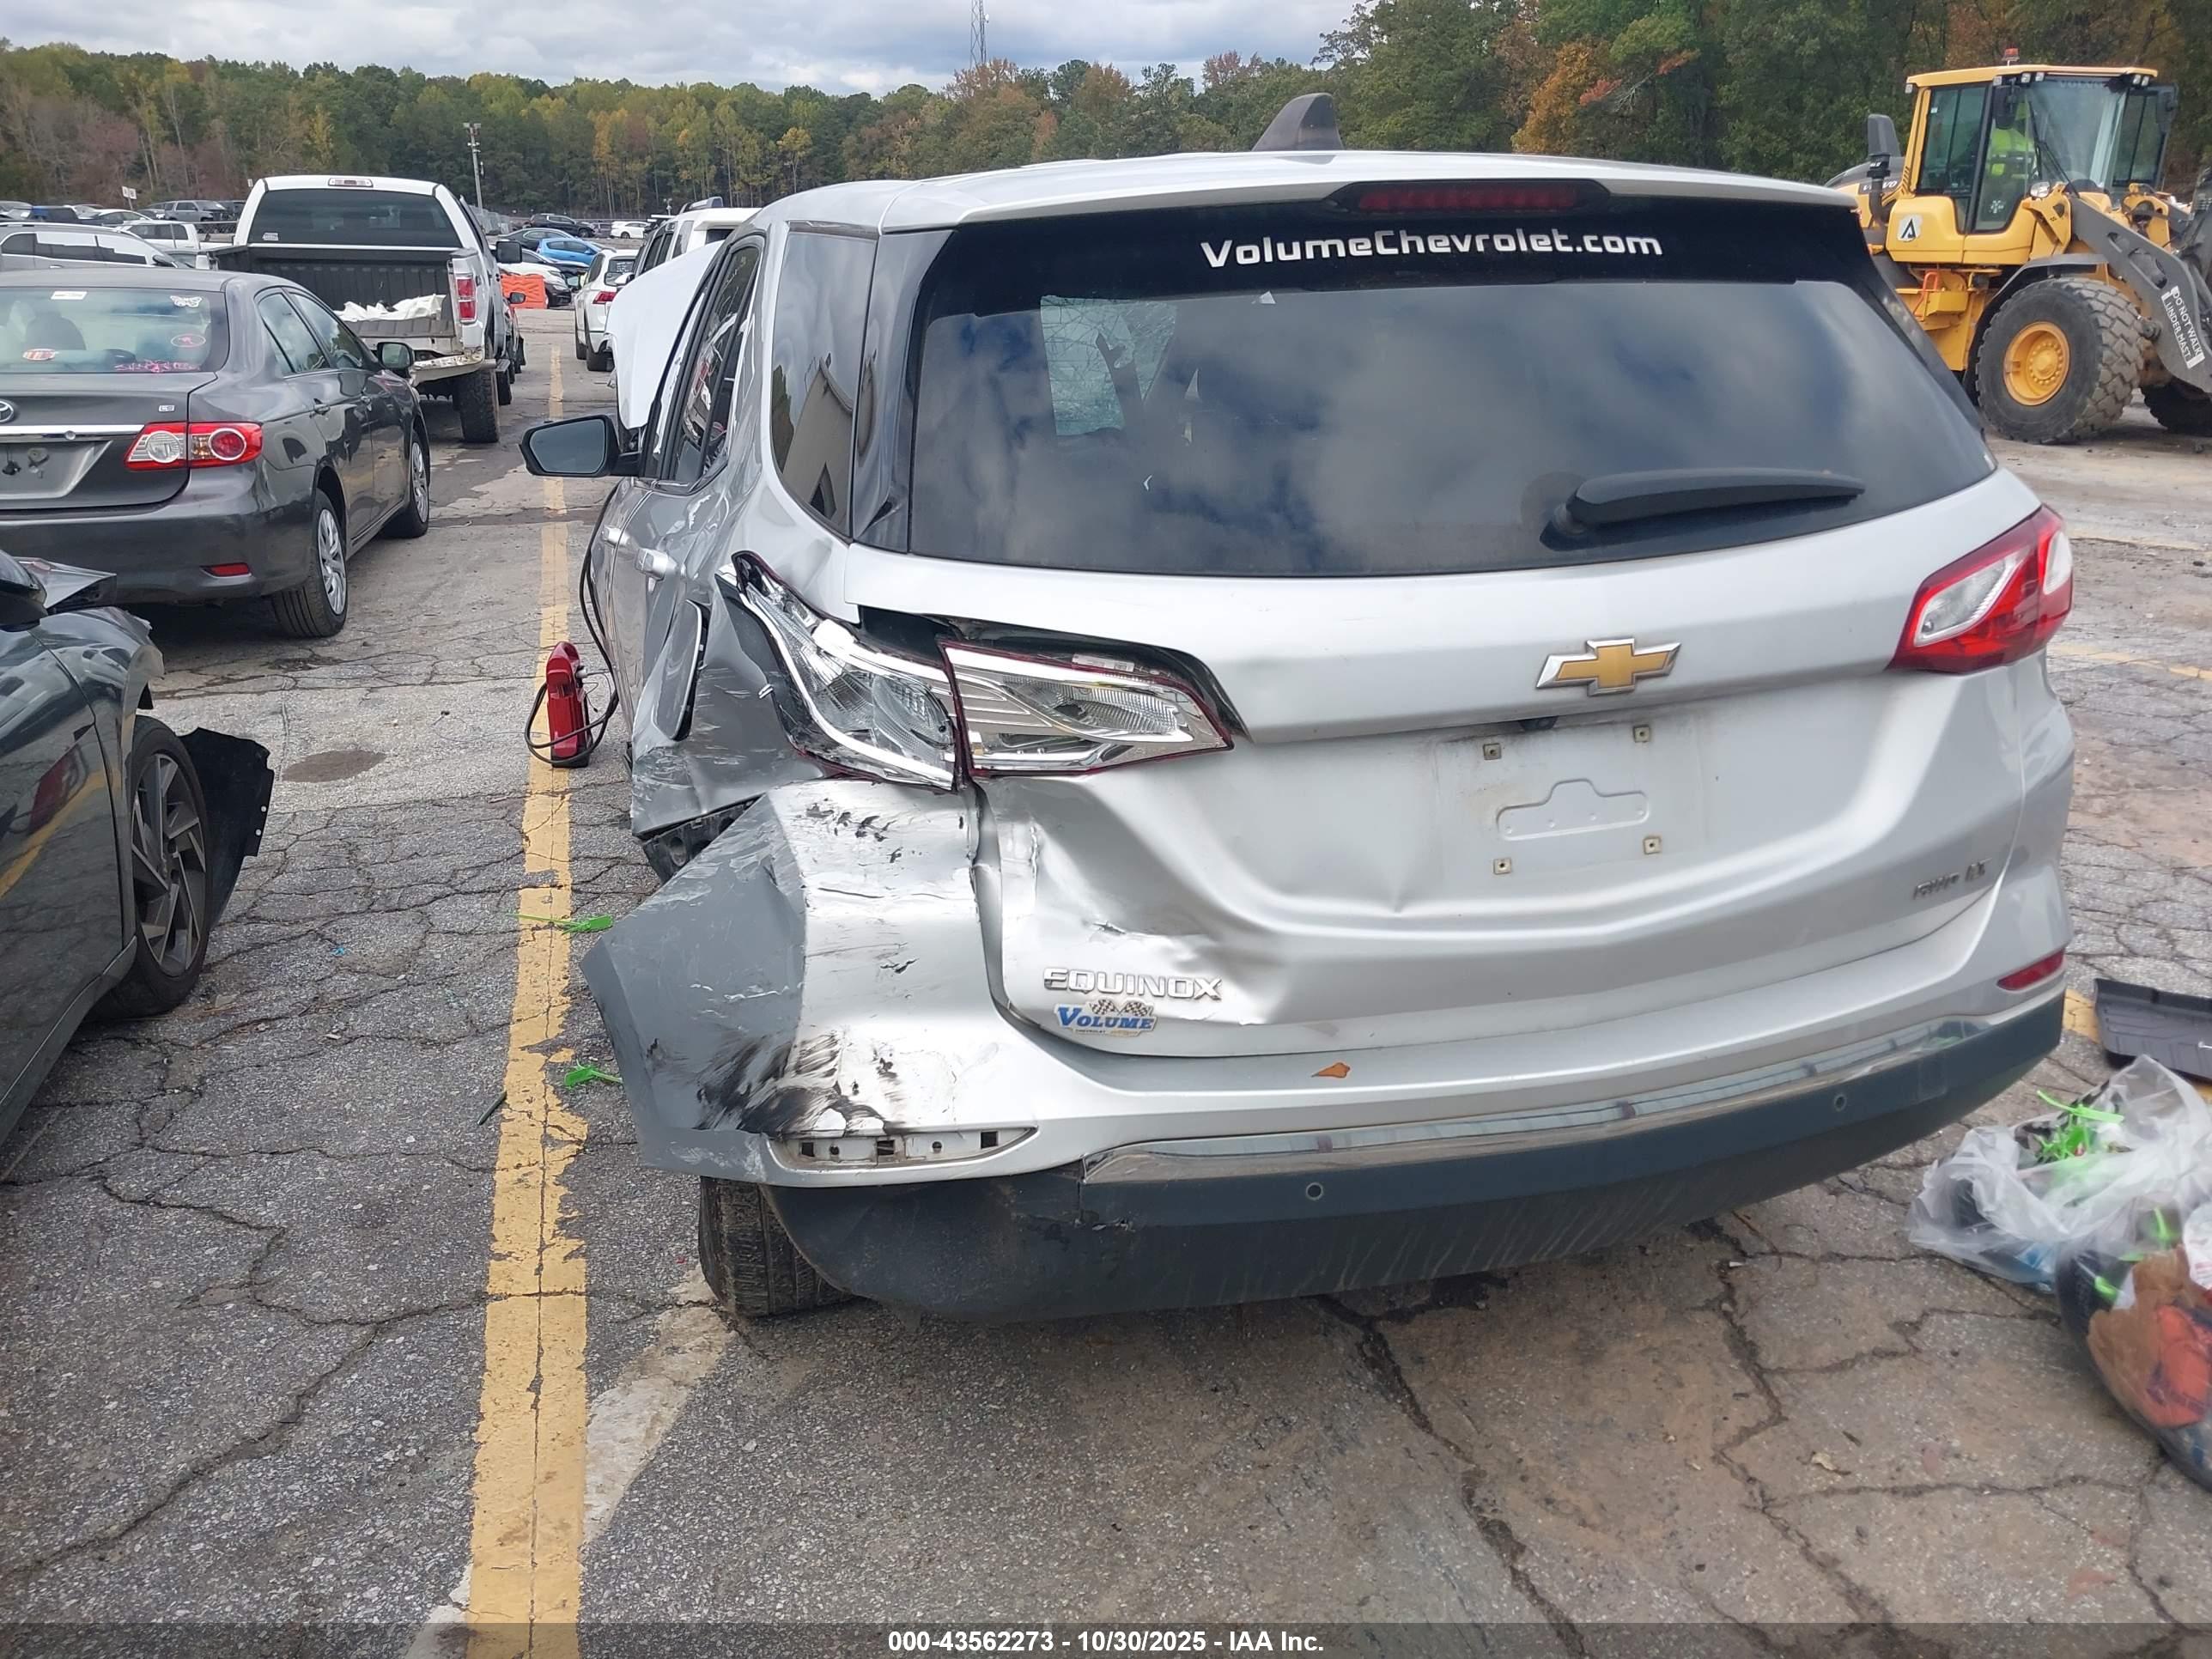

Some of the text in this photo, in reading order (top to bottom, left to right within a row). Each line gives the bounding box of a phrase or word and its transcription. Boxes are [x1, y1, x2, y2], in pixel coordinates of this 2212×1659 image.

[1200, 228, 1663, 268] VolumeChevrolet.com
[2165, 301, 2191, 357] UNDER MAST
[2172, 290, 2203, 356] DO NOT WALK
[1043, 968, 1223, 1000] EQUINOX
[1057, 1006, 1156, 1030] VOLUME
